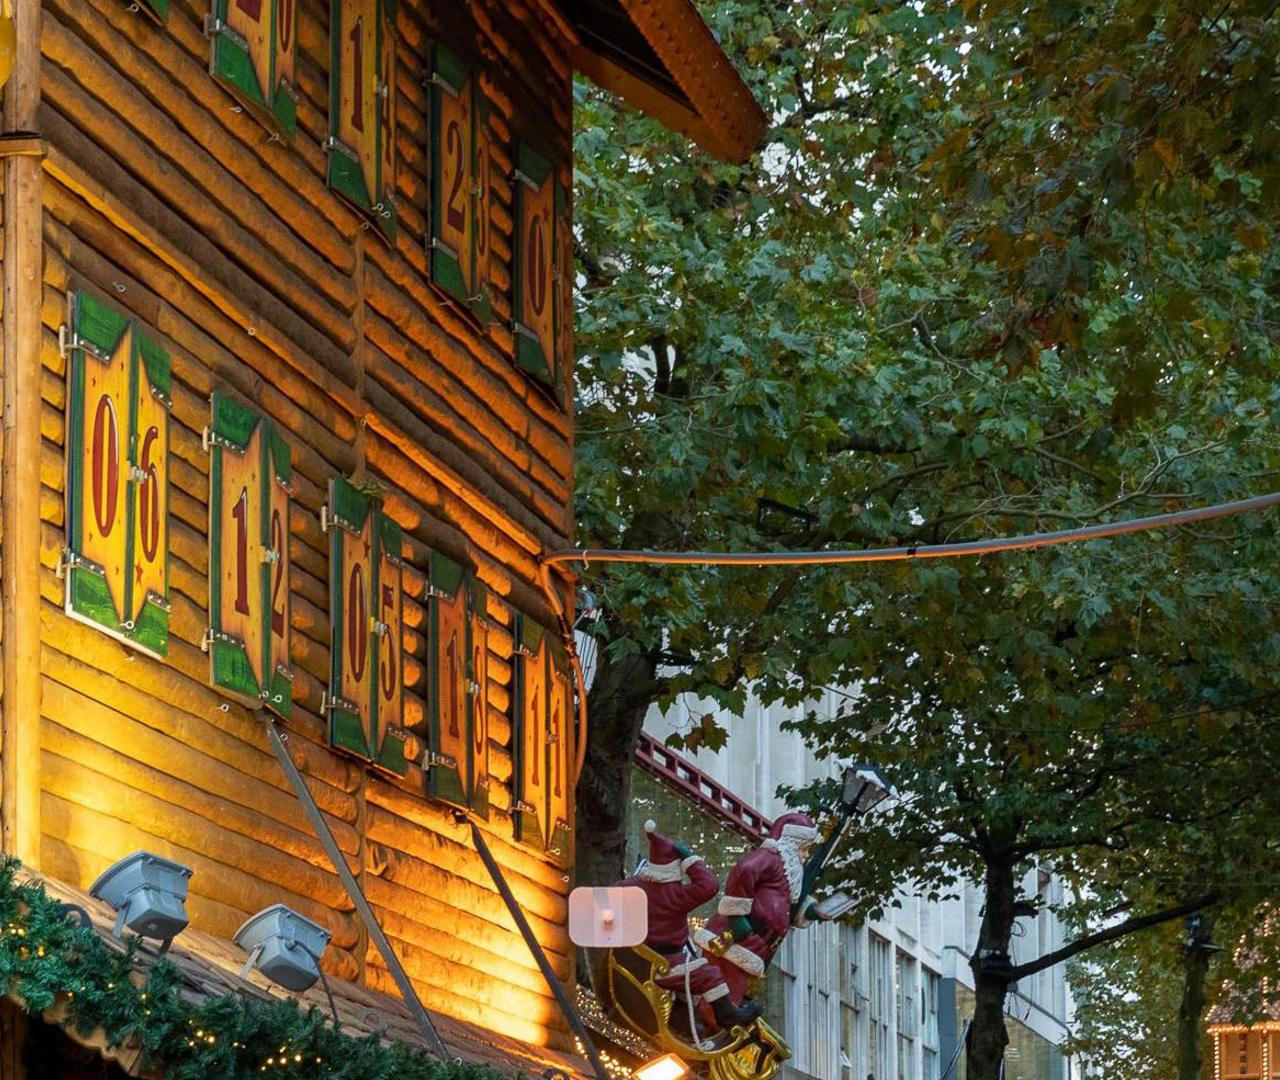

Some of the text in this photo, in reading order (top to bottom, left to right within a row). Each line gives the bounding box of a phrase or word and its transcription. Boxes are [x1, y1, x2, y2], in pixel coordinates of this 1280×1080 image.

[92, 393, 160, 564] 06
[232, 485, 284, 639] 12
[347, 562, 397, 701] 05
